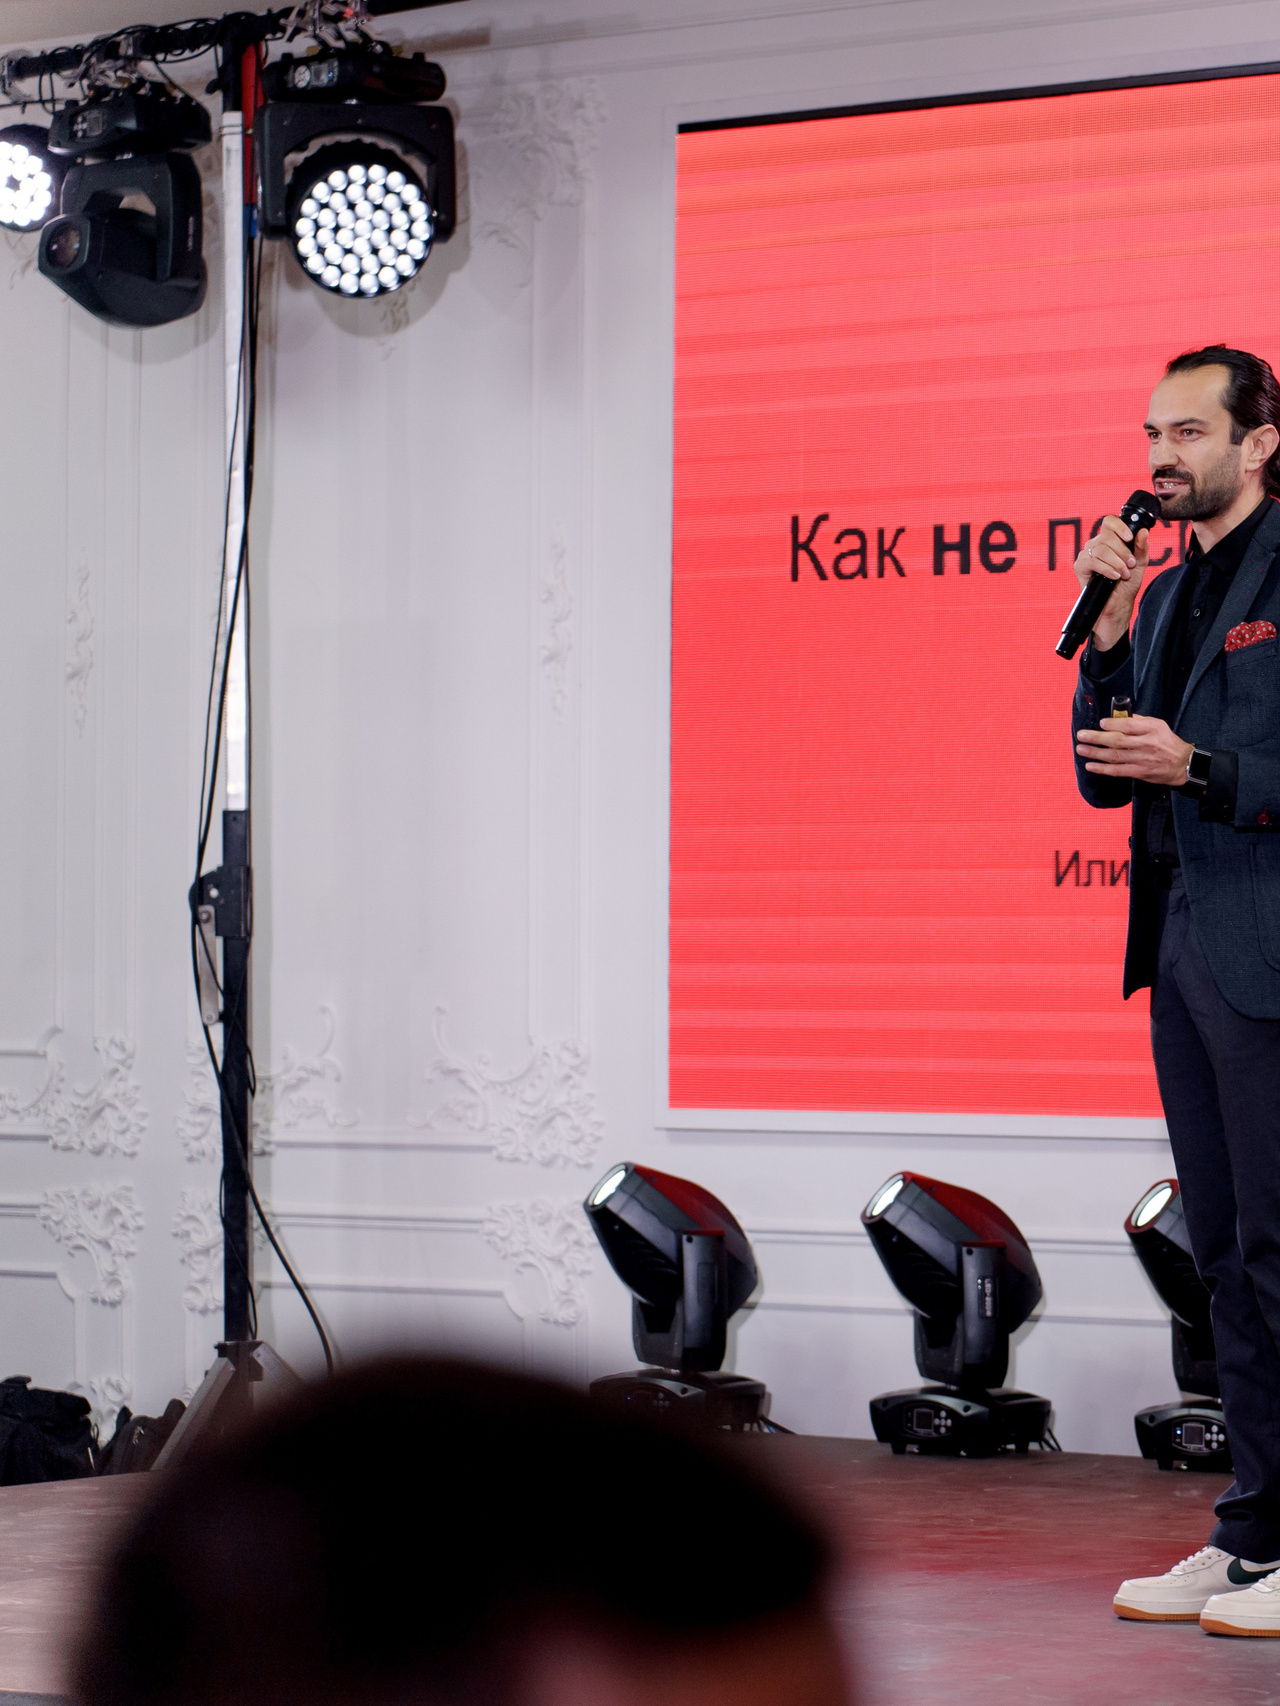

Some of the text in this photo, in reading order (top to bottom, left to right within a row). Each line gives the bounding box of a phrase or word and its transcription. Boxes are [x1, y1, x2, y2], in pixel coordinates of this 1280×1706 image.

[790, 513, 907, 582] Как
[933, 520, 1018, 576] не
[1055, 850, 1130, 887] Или
